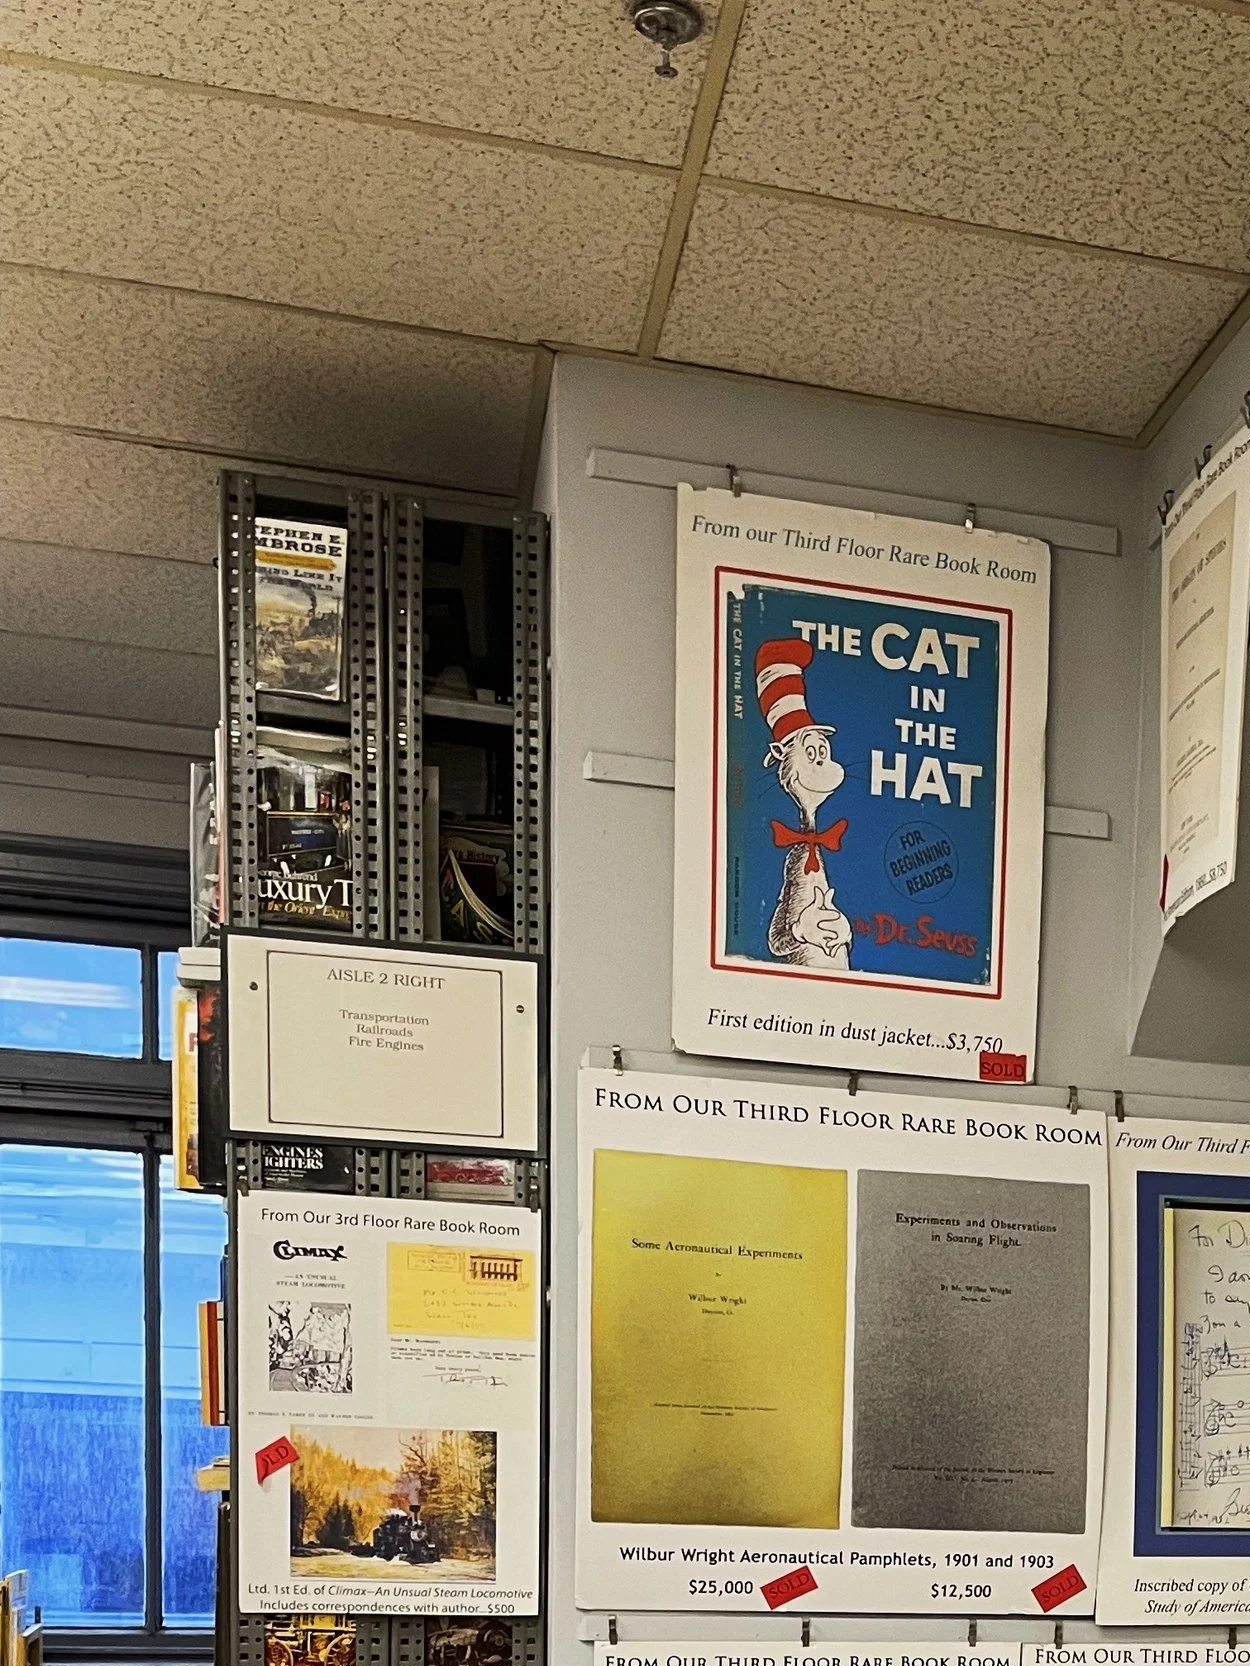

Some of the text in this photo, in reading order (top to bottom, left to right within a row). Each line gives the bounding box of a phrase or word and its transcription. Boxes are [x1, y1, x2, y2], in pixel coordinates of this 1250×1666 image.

[793, 620, 979, 678] THE CAT
[911, 686, 945, 712] IN
[895, 719, 956, 750] THE
[871, 750, 982, 808] HAT
[327, 969, 445, 989] AISLE 2 RIGHT
[339, 1009, 429, 1025] Transportation
[708, 1009, 747, 1028] First
[754, 1015, 812, 1035] edition
[820, 1025, 834, 1037] in
[841, 1022, 876, 1041] dust
[357, 1024, 413, 1037] Railroads
[350, 1036, 423, 1051] Fire Engines
[262, 1208, 519, 1235] From Our 3rd Floor Rare Book Room
[620, 1547, 1053, 1568] Wilbur Wright Aeronautical Pamphlets, 1901 and 1903
[689, 1580, 753, 1596] $25,000
[932, 1583, 991, 1599] $12,500
[1135, 1579, 1194, 1591] Inscribed
[1198, 1583, 1228, 1595] copy
[1232, 1578, 1247, 1591] of
